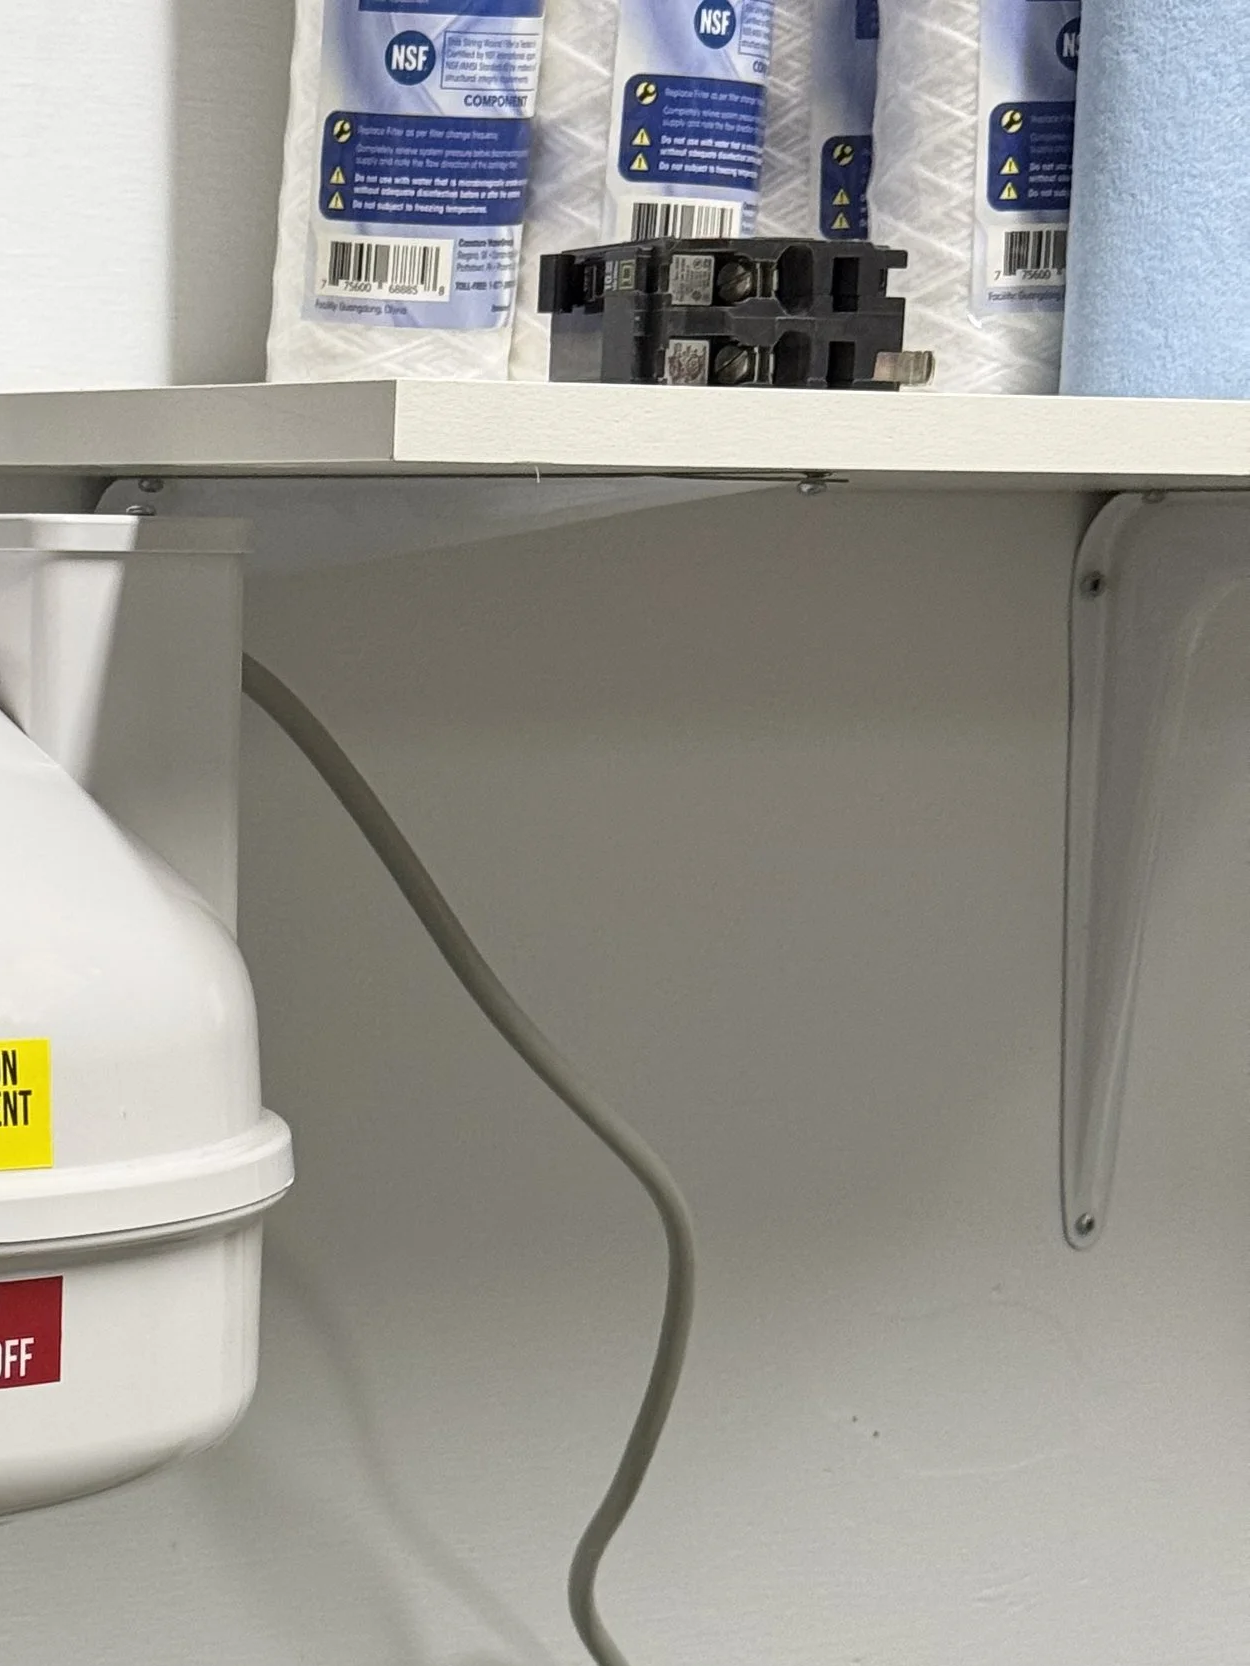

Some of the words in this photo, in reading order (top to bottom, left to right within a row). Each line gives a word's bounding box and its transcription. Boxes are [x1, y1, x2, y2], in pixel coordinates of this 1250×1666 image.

[700, 9, 731, 36] NSF
[391, 44, 429, 72] NSF
[464, 94, 527, 107] COMPONENT
[355, 173, 365, 183] Do
[366, 174, 378, 184] not
[353, 185, 380, 195] without
[381, 187, 415, 198] adequate
[352, 199, 363, 209] Do
[364, 200, 377, 210] not
[377, 201, 404, 212] subject
[414, 203, 444, 215] freezing
[994, 271, 1001, 281] 7
[321, 280, 327, 289] 7
[343, 282, 372, 293] 75600
[438, 286, 445, 296] 8
